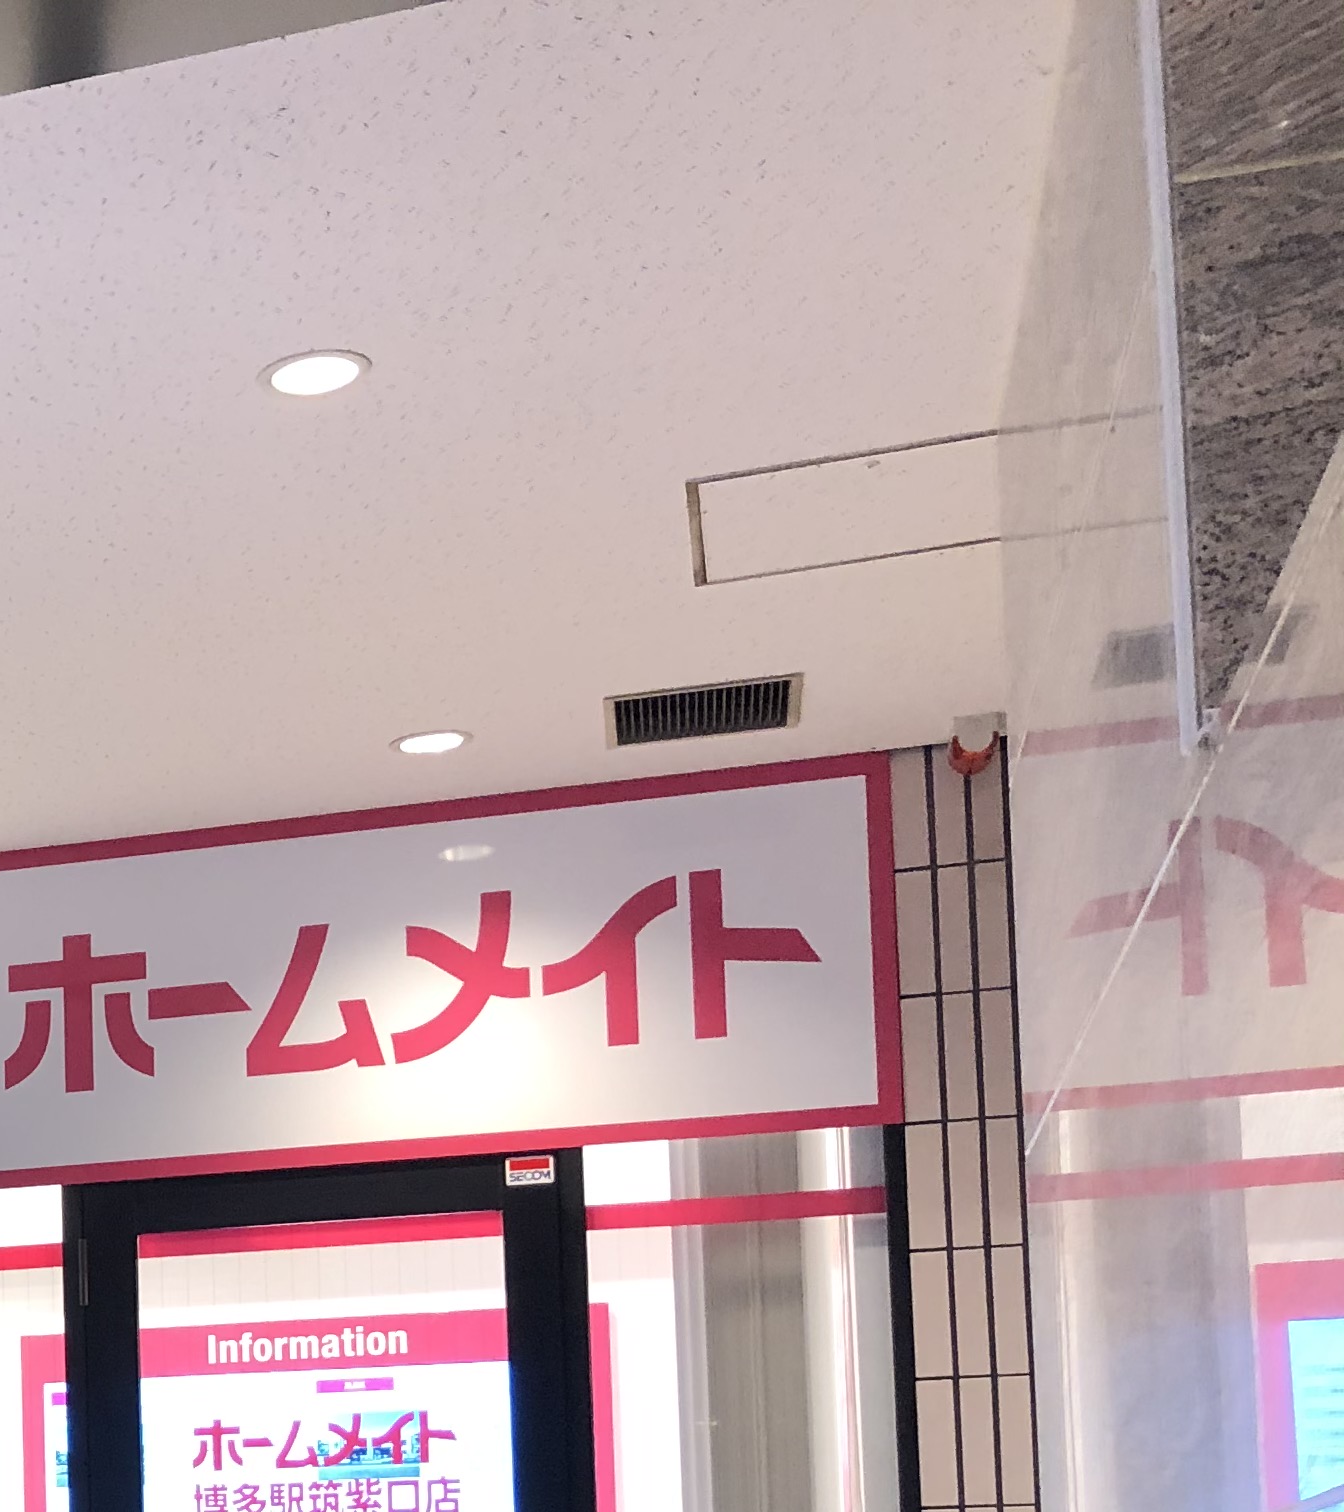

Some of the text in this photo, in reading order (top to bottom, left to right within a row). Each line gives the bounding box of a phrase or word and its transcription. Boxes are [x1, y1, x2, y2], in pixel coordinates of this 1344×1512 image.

[3, 868, 822, 1094] ホームメイト
[509, 1170, 551, 1182] SECOM
[207, 1326, 409, 1365] Information
[192, 1410, 457, 1471] ホームメイト
